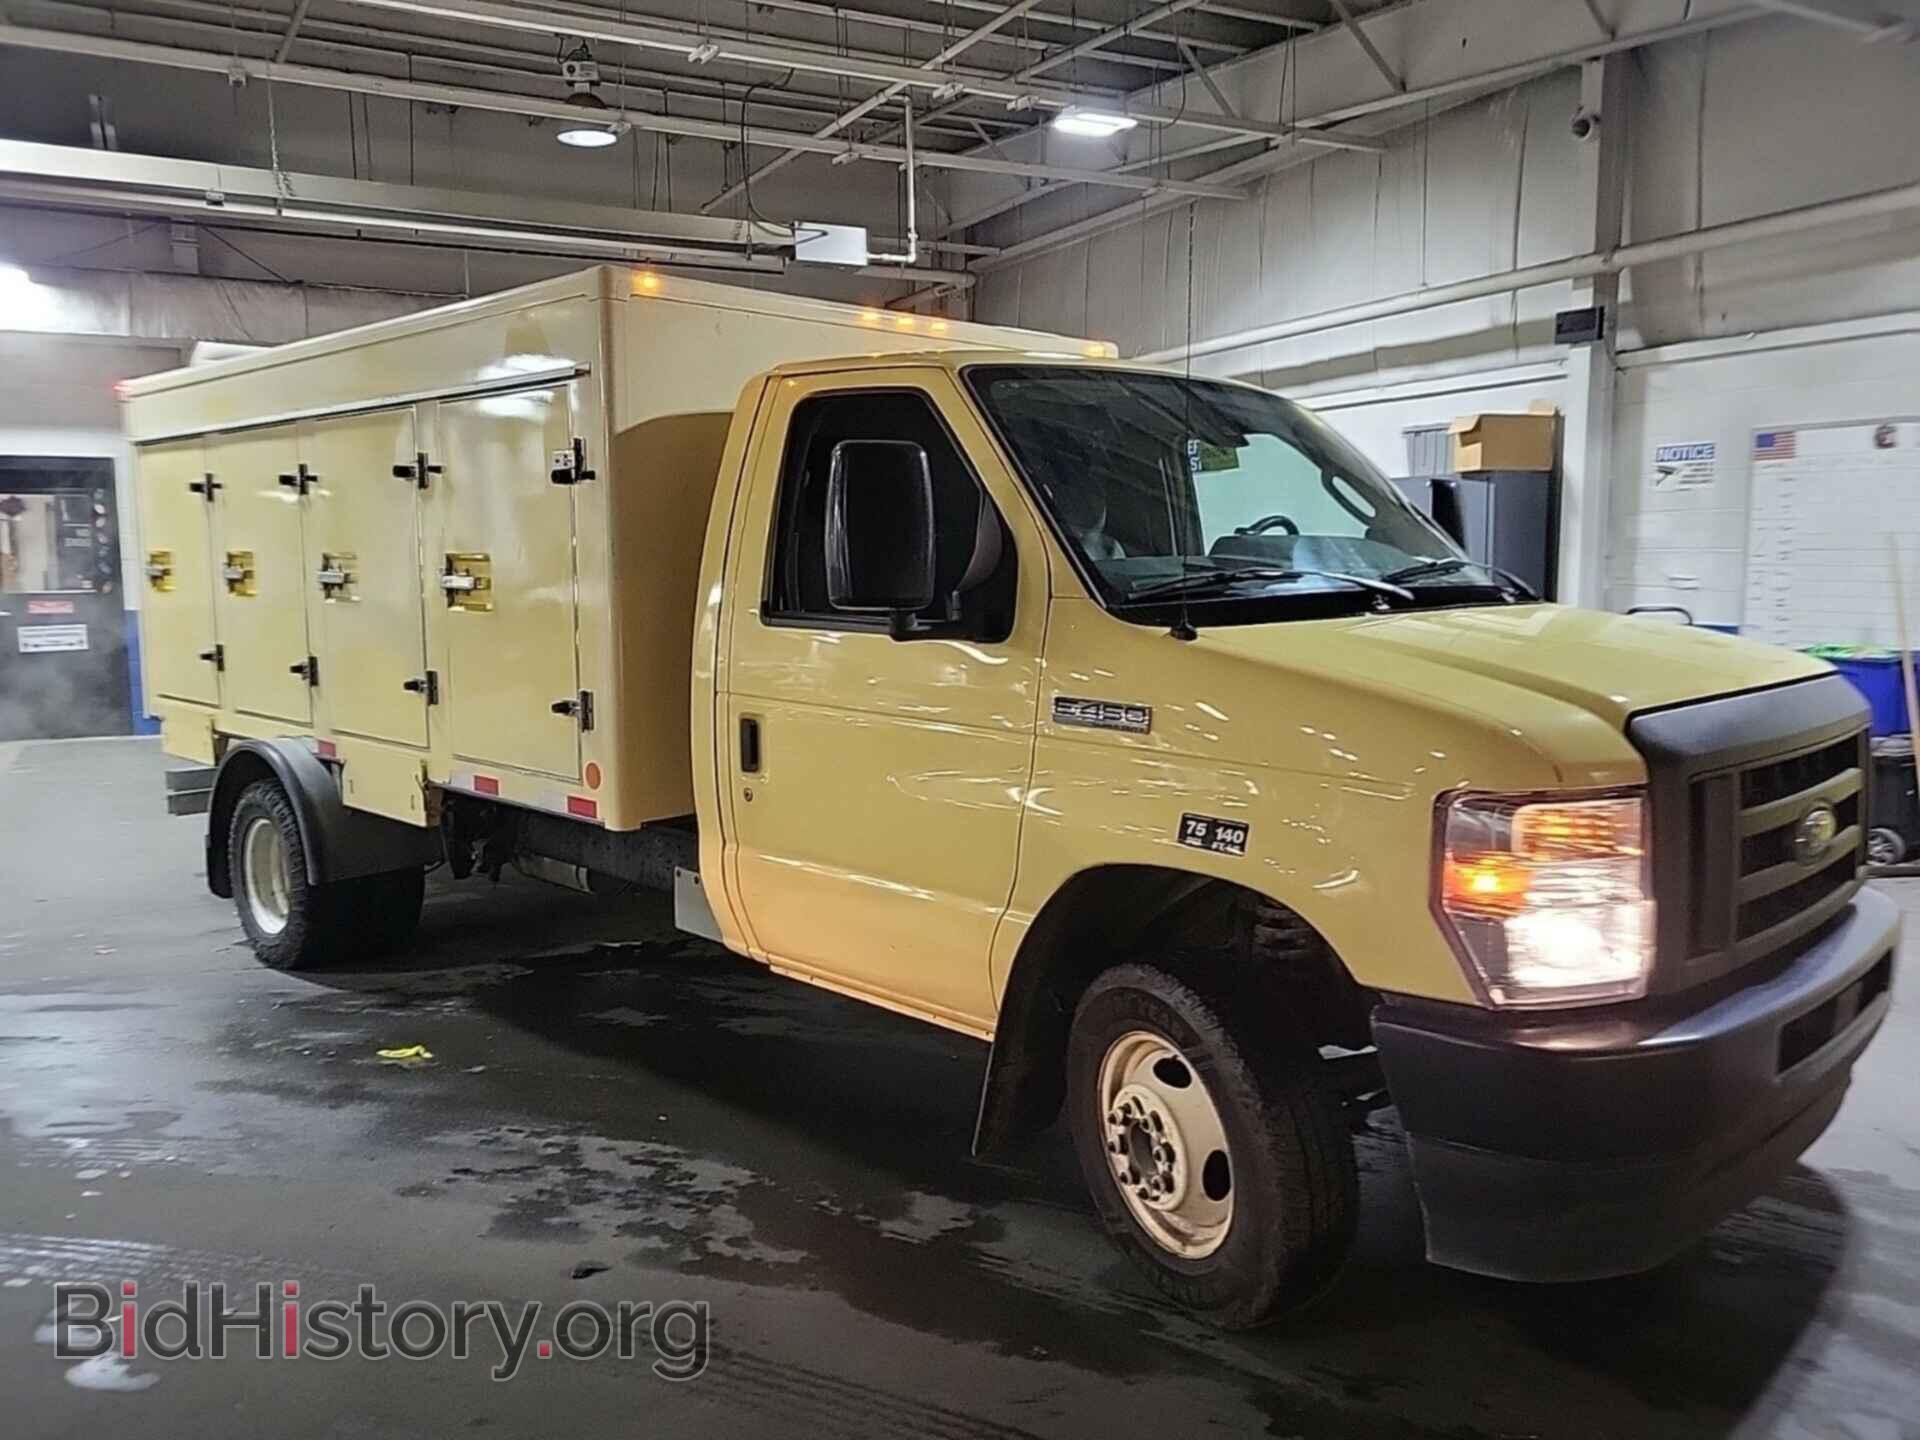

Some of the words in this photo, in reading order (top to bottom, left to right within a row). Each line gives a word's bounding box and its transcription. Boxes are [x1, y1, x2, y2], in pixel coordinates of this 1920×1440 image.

[1657, 446, 1713, 461] NOTICE
[1186, 820, 1207, 836] 75
[1215, 826, 1245, 844] 140
